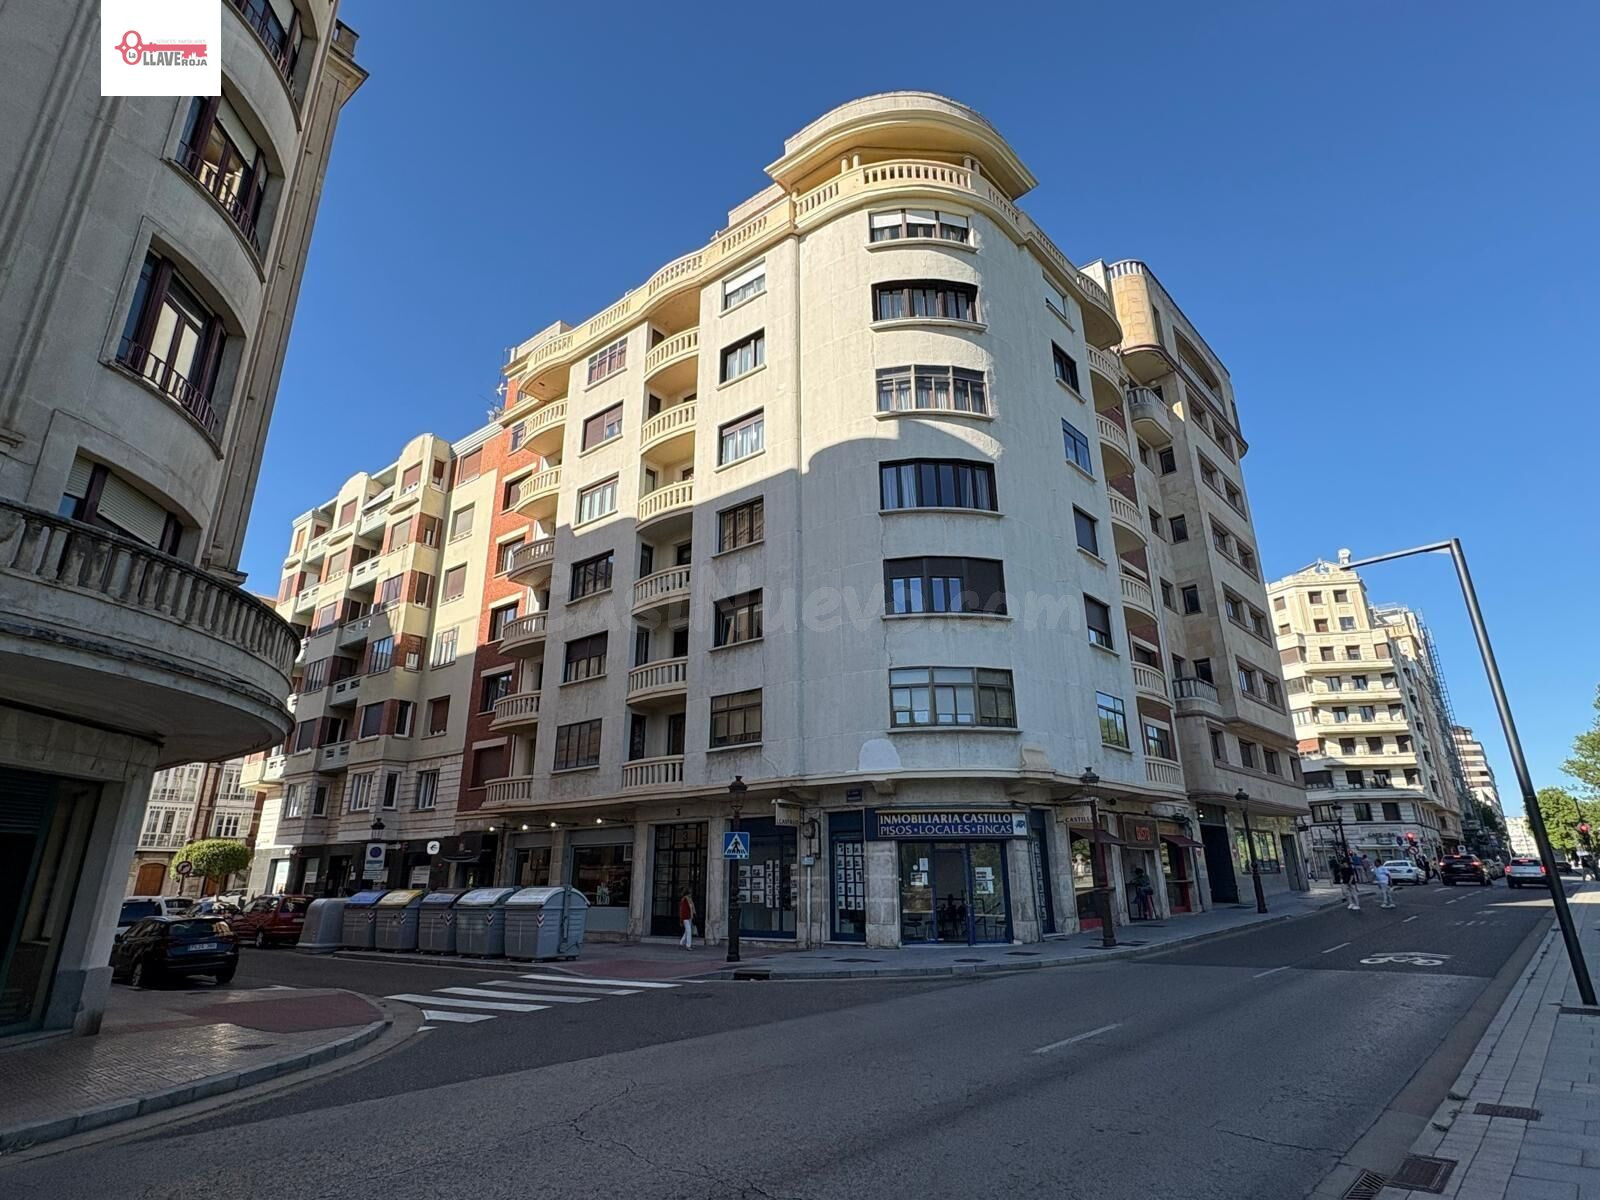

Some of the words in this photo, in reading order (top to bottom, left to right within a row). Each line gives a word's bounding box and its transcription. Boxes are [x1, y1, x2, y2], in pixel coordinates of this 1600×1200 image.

[879, 813, 961, 825] INMOBILIARIA
[962, 813, 1012, 824] CASTILLO
[880, 825, 913, 835] PISOS
[919, 824, 971, 835] LOCALES
[976, 824, 1013, 834] FINCAS
[682, 831, 689, 841] 3
